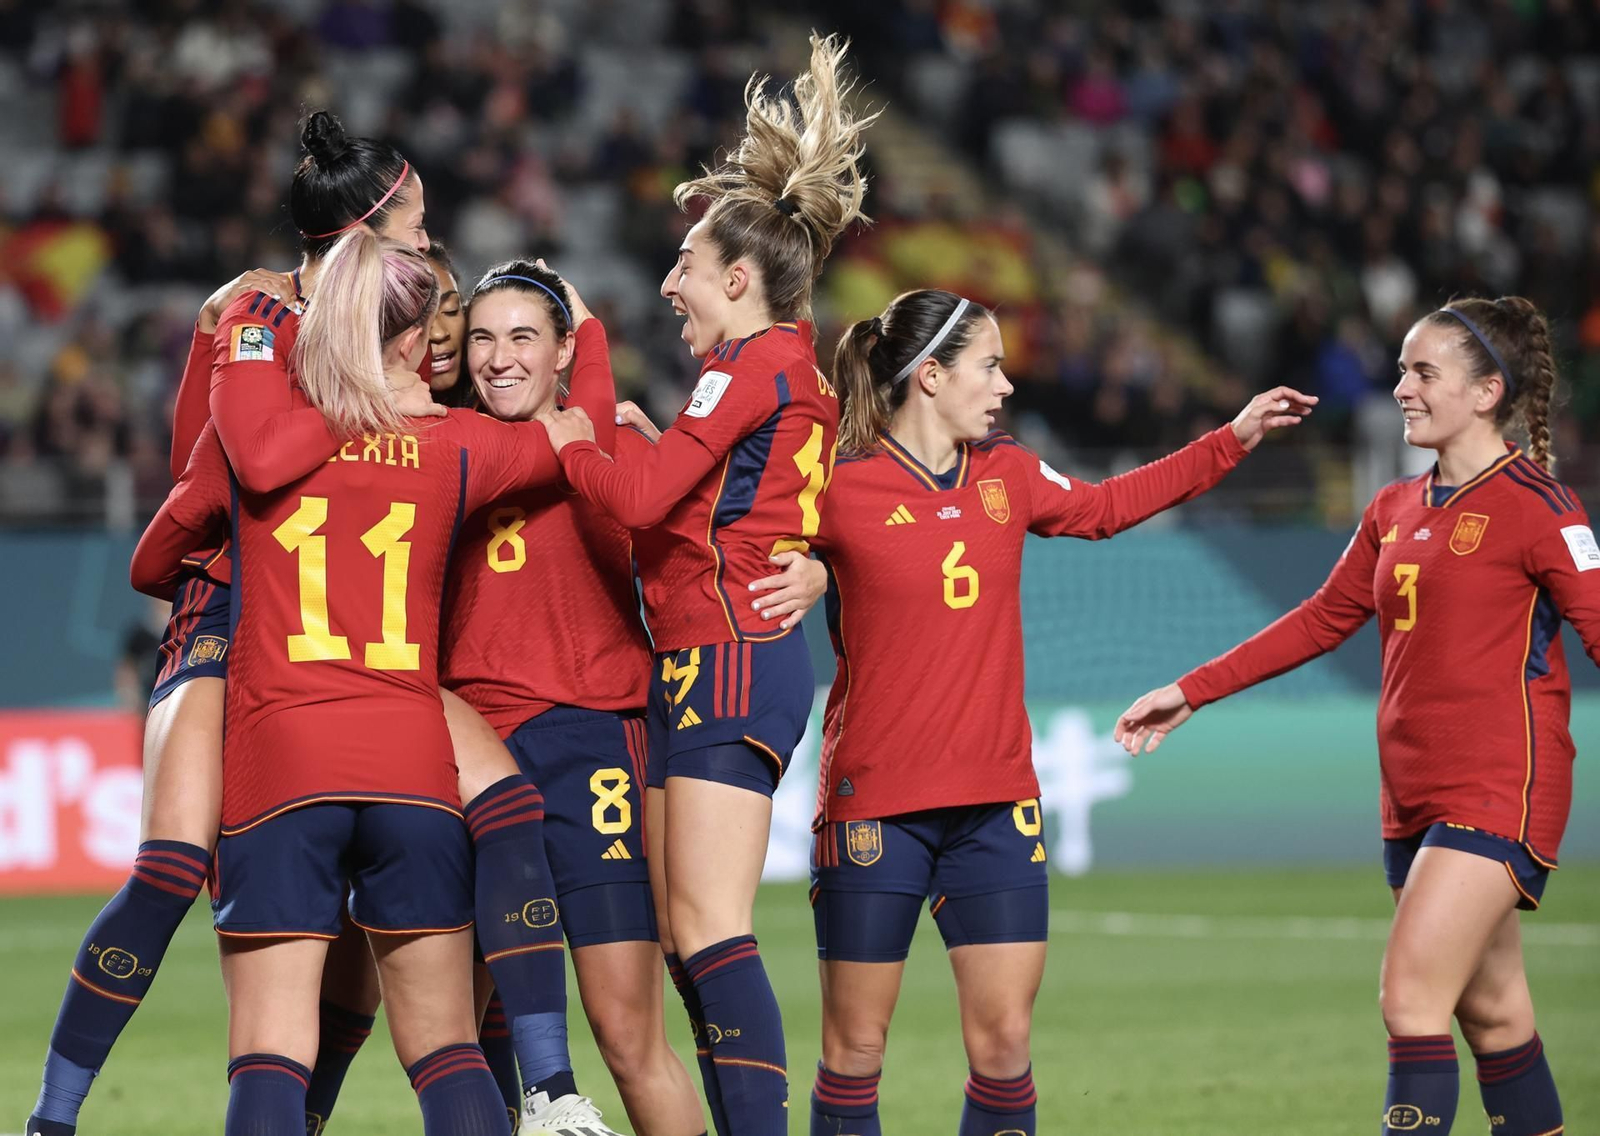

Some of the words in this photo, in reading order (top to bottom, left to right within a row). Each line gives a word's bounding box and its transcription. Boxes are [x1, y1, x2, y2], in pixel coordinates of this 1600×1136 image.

[328, 432, 420, 469] EXIA
[487, 507, 527, 574] 8
[272, 496, 421, 671] 11
[942, 541, 979, 610] 6
[1393, 563, 1420, 632] 3
[589, 767, 632, 835] 8
